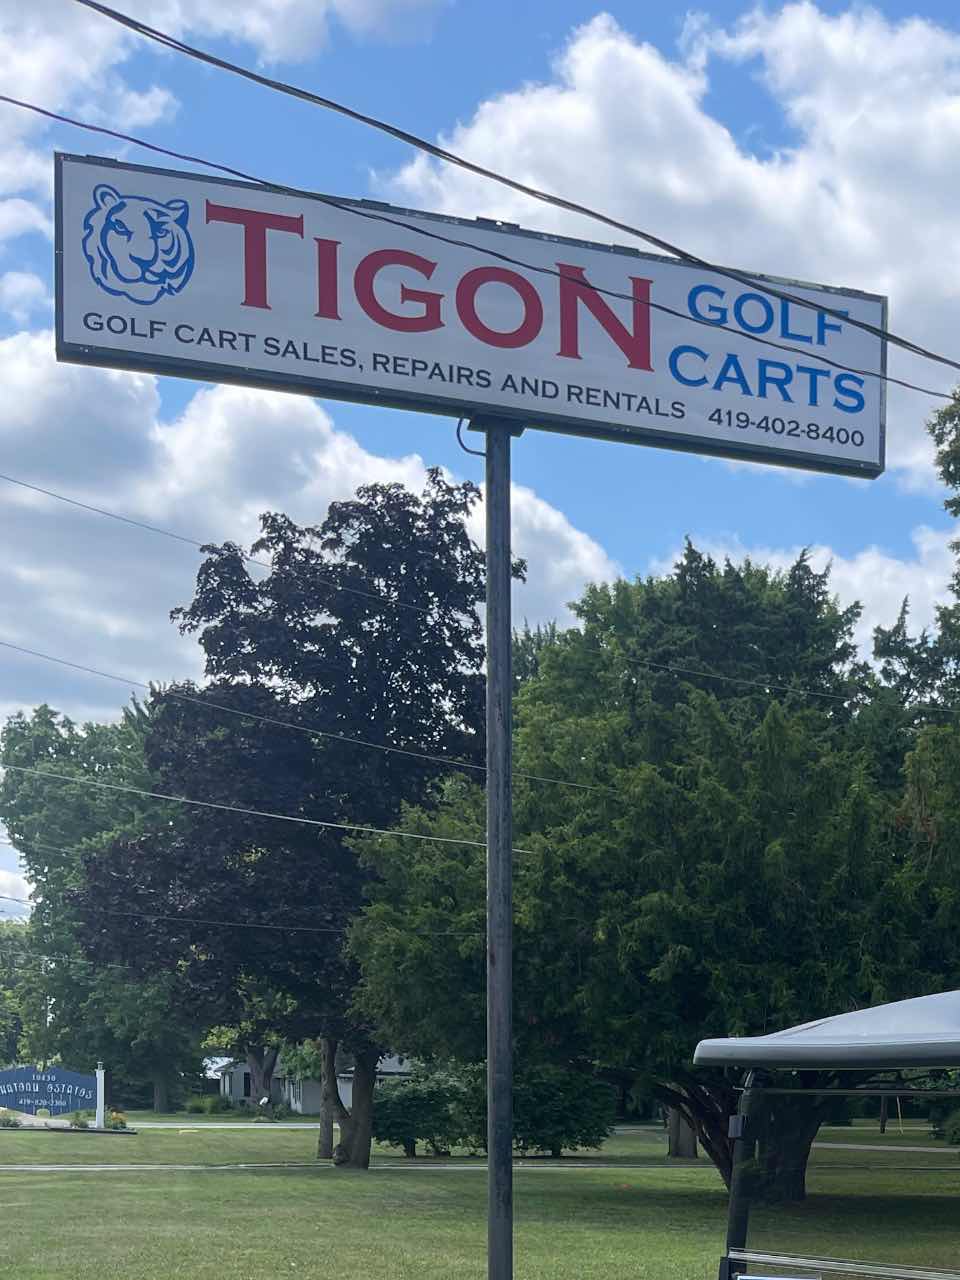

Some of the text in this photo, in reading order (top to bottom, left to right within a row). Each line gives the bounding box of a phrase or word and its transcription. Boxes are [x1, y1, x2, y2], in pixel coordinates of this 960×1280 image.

[687, 284, 849, 346] GOLF
[83, 312, 686, 419] GOLF CART SALES, REPAIRS AND RENTALS
[669, 344, 865, 414] CARTS
[708, 408, 865, 448] 419-402-8400
